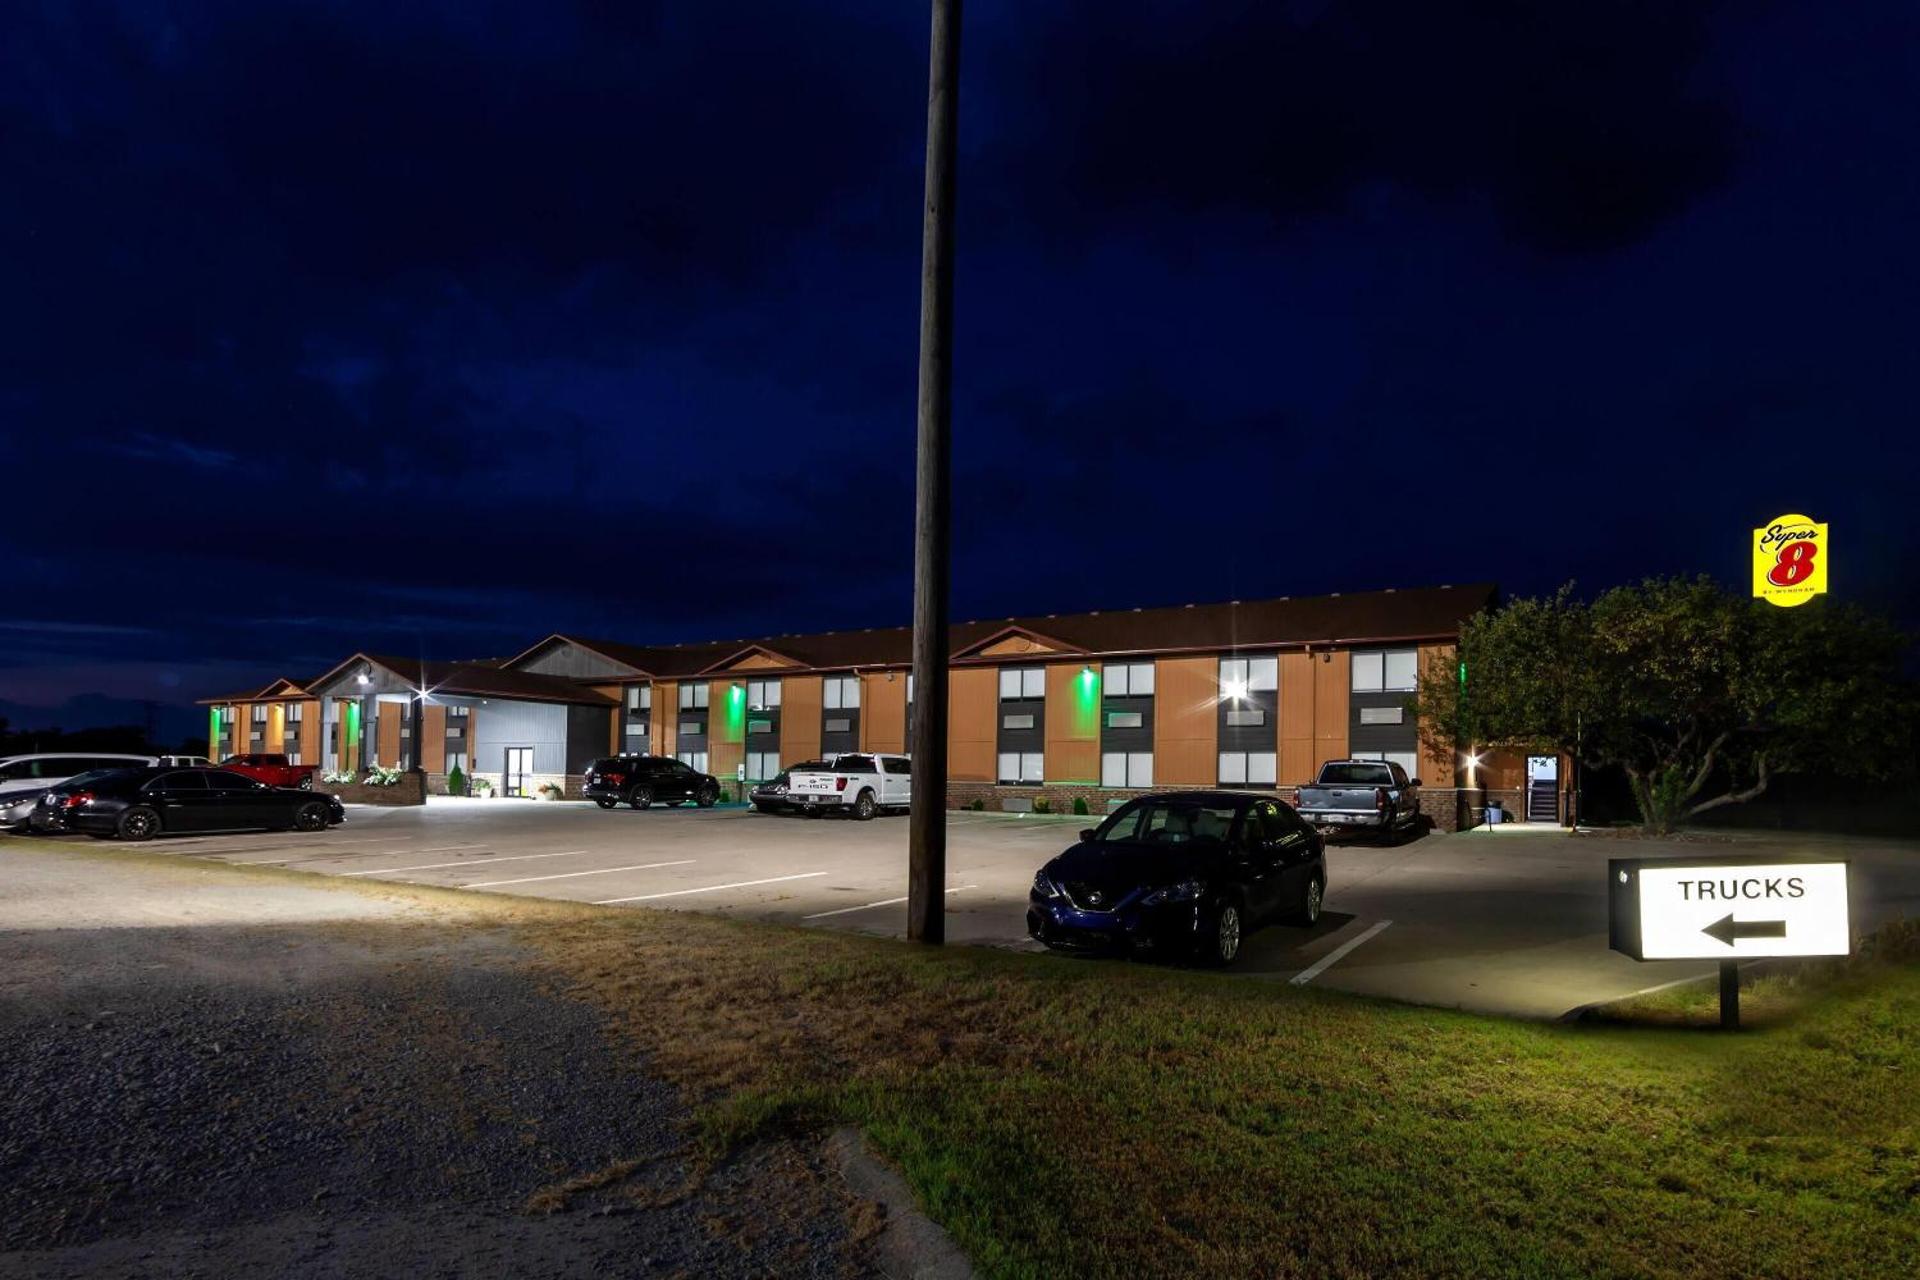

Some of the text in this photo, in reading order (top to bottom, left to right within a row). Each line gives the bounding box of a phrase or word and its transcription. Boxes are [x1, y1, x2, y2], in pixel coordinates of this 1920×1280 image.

[1760, 524, 1818, 551] Super
[1766, 541, 1818, 586] 8
[1678, 877, 1805, 900] TRUCKS
